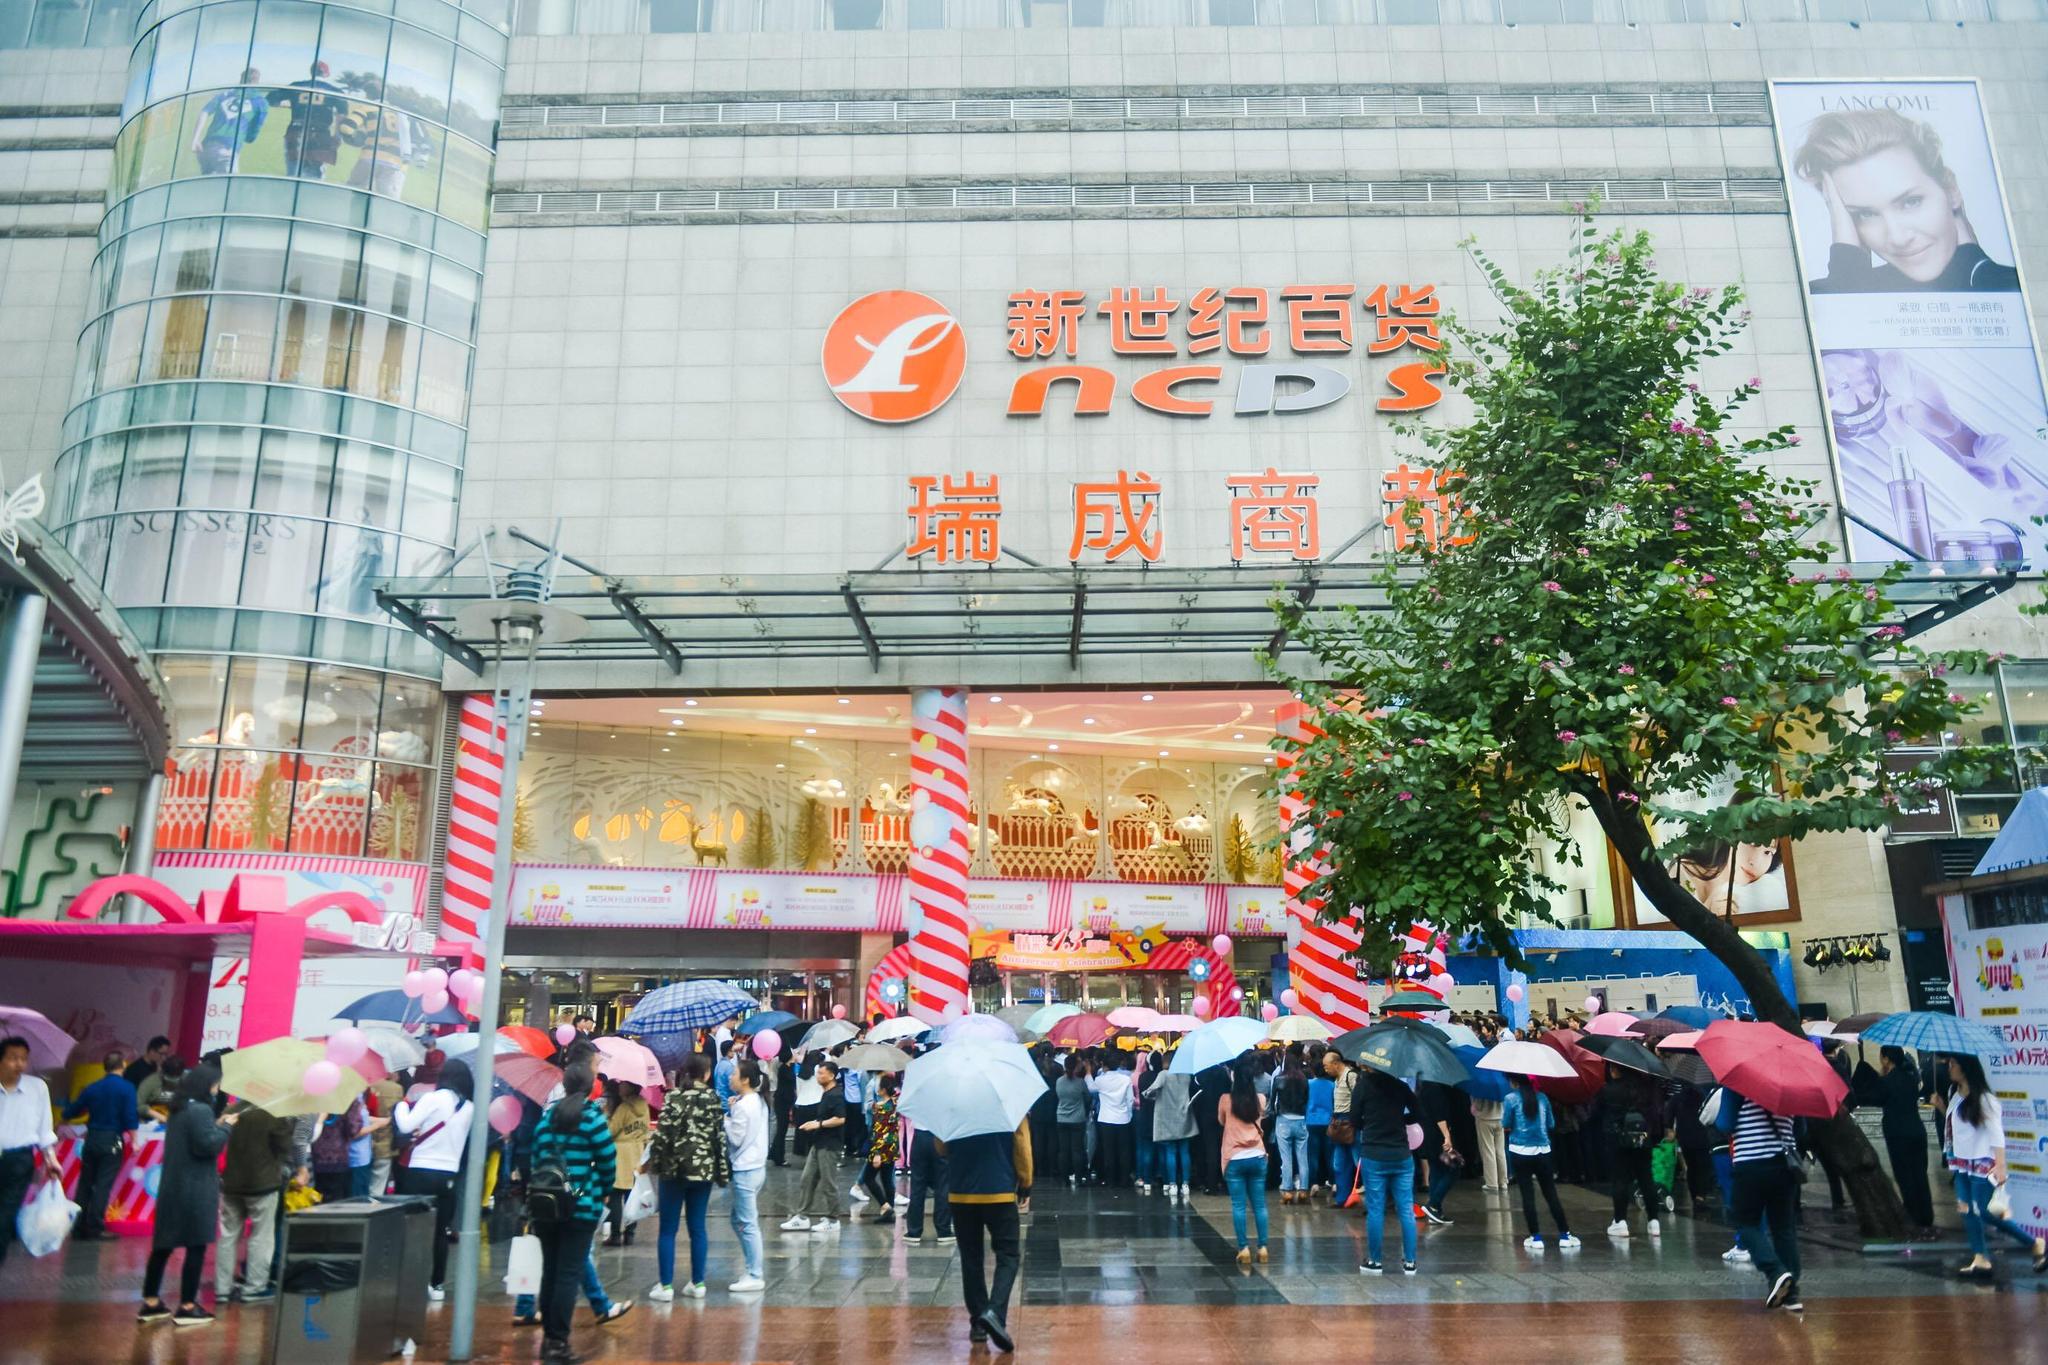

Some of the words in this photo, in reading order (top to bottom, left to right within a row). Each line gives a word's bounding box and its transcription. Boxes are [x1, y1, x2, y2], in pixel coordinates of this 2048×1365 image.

[1006, 284, 1442, 358] 新世纪百货
[905, 464, 1479, 565] 瑞成商都
